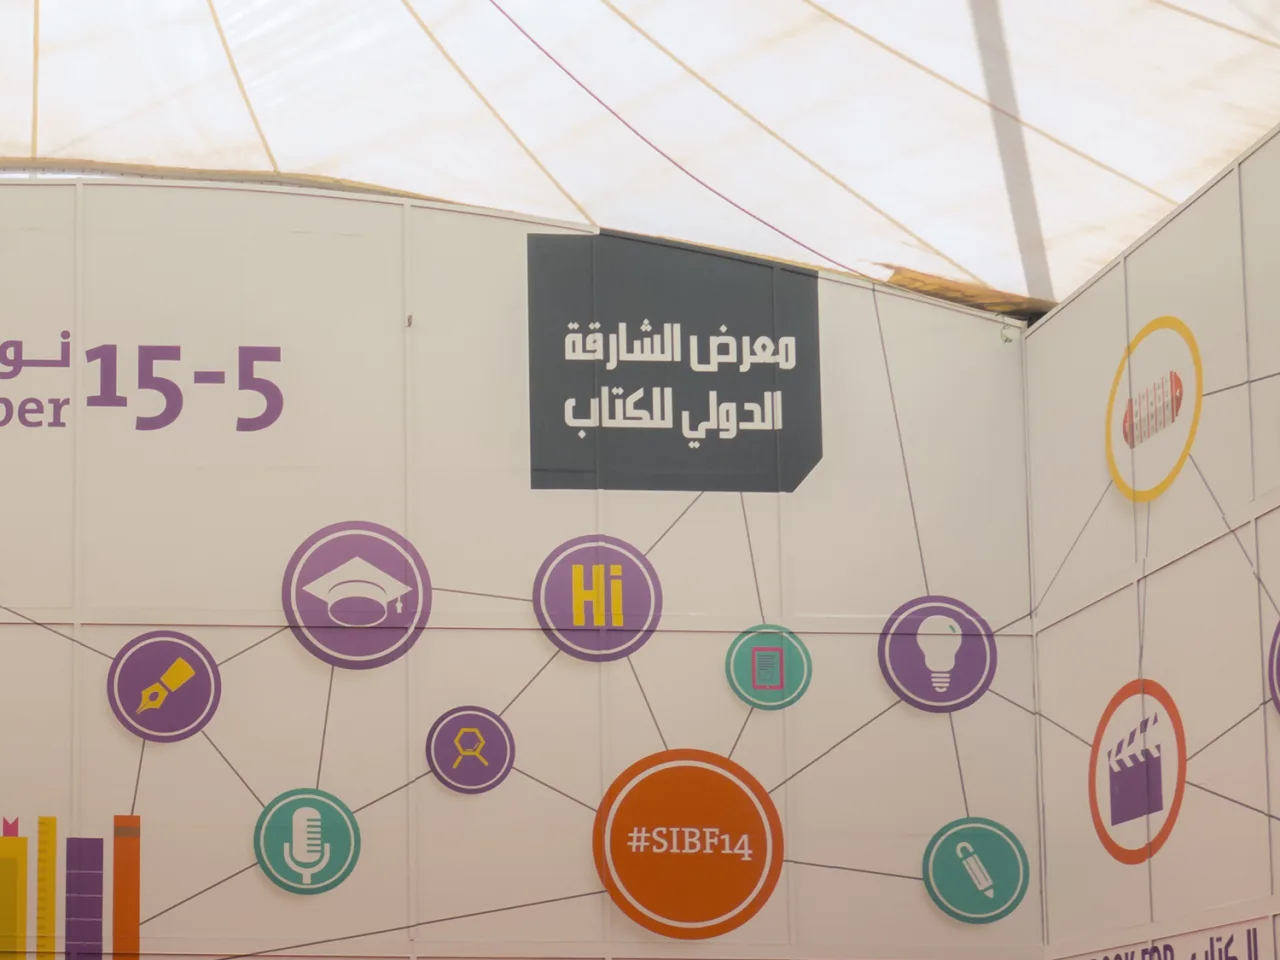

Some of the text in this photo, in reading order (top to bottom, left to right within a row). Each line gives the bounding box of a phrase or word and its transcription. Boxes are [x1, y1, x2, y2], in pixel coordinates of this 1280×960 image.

[564, 318, 796, 372] معرض الشارقة
[564, 386, 782, 449] الدولي للكتاب
[571, 564, 624, 627] Hi
[626, 826, 753, 861] #SIBF14
